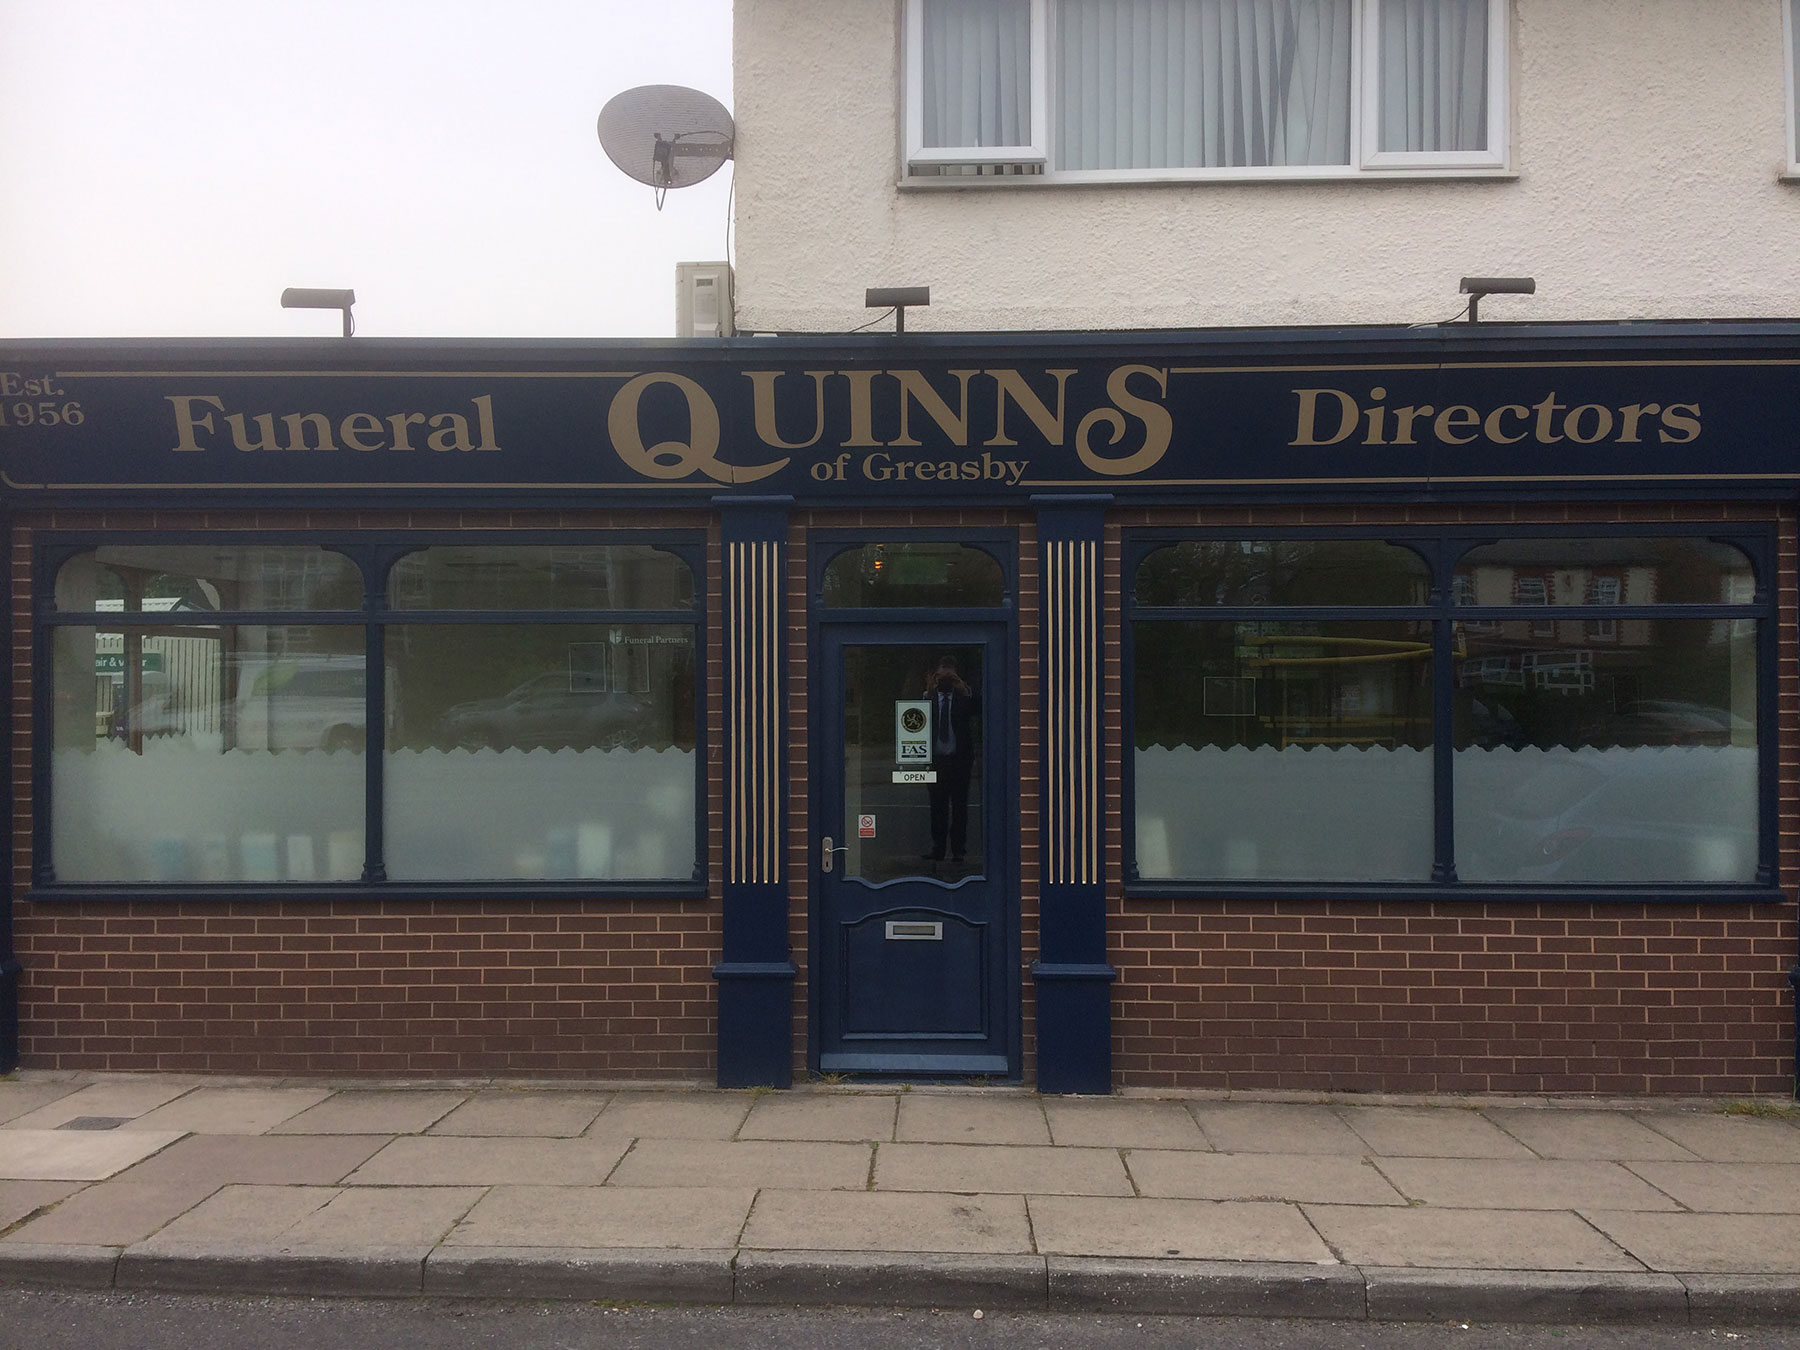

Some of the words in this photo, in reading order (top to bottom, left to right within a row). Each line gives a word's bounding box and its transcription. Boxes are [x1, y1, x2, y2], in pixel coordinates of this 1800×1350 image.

[0, 372, 65, 396] Est.
[0, 401, 85, 426] 1956
[164, 394, 502, 452] Funeral
[608, 364, 1173, 483] QUINNS
[1288, 387, 1701, 446] Directors
[811, 452, 849, 480] of
[862, 453, 1029, 485] Greasby
[624, 636, 653, 644] Funeral
[655, 636, 688, 644] Partners
[901, 745, 927, 754] FAS
